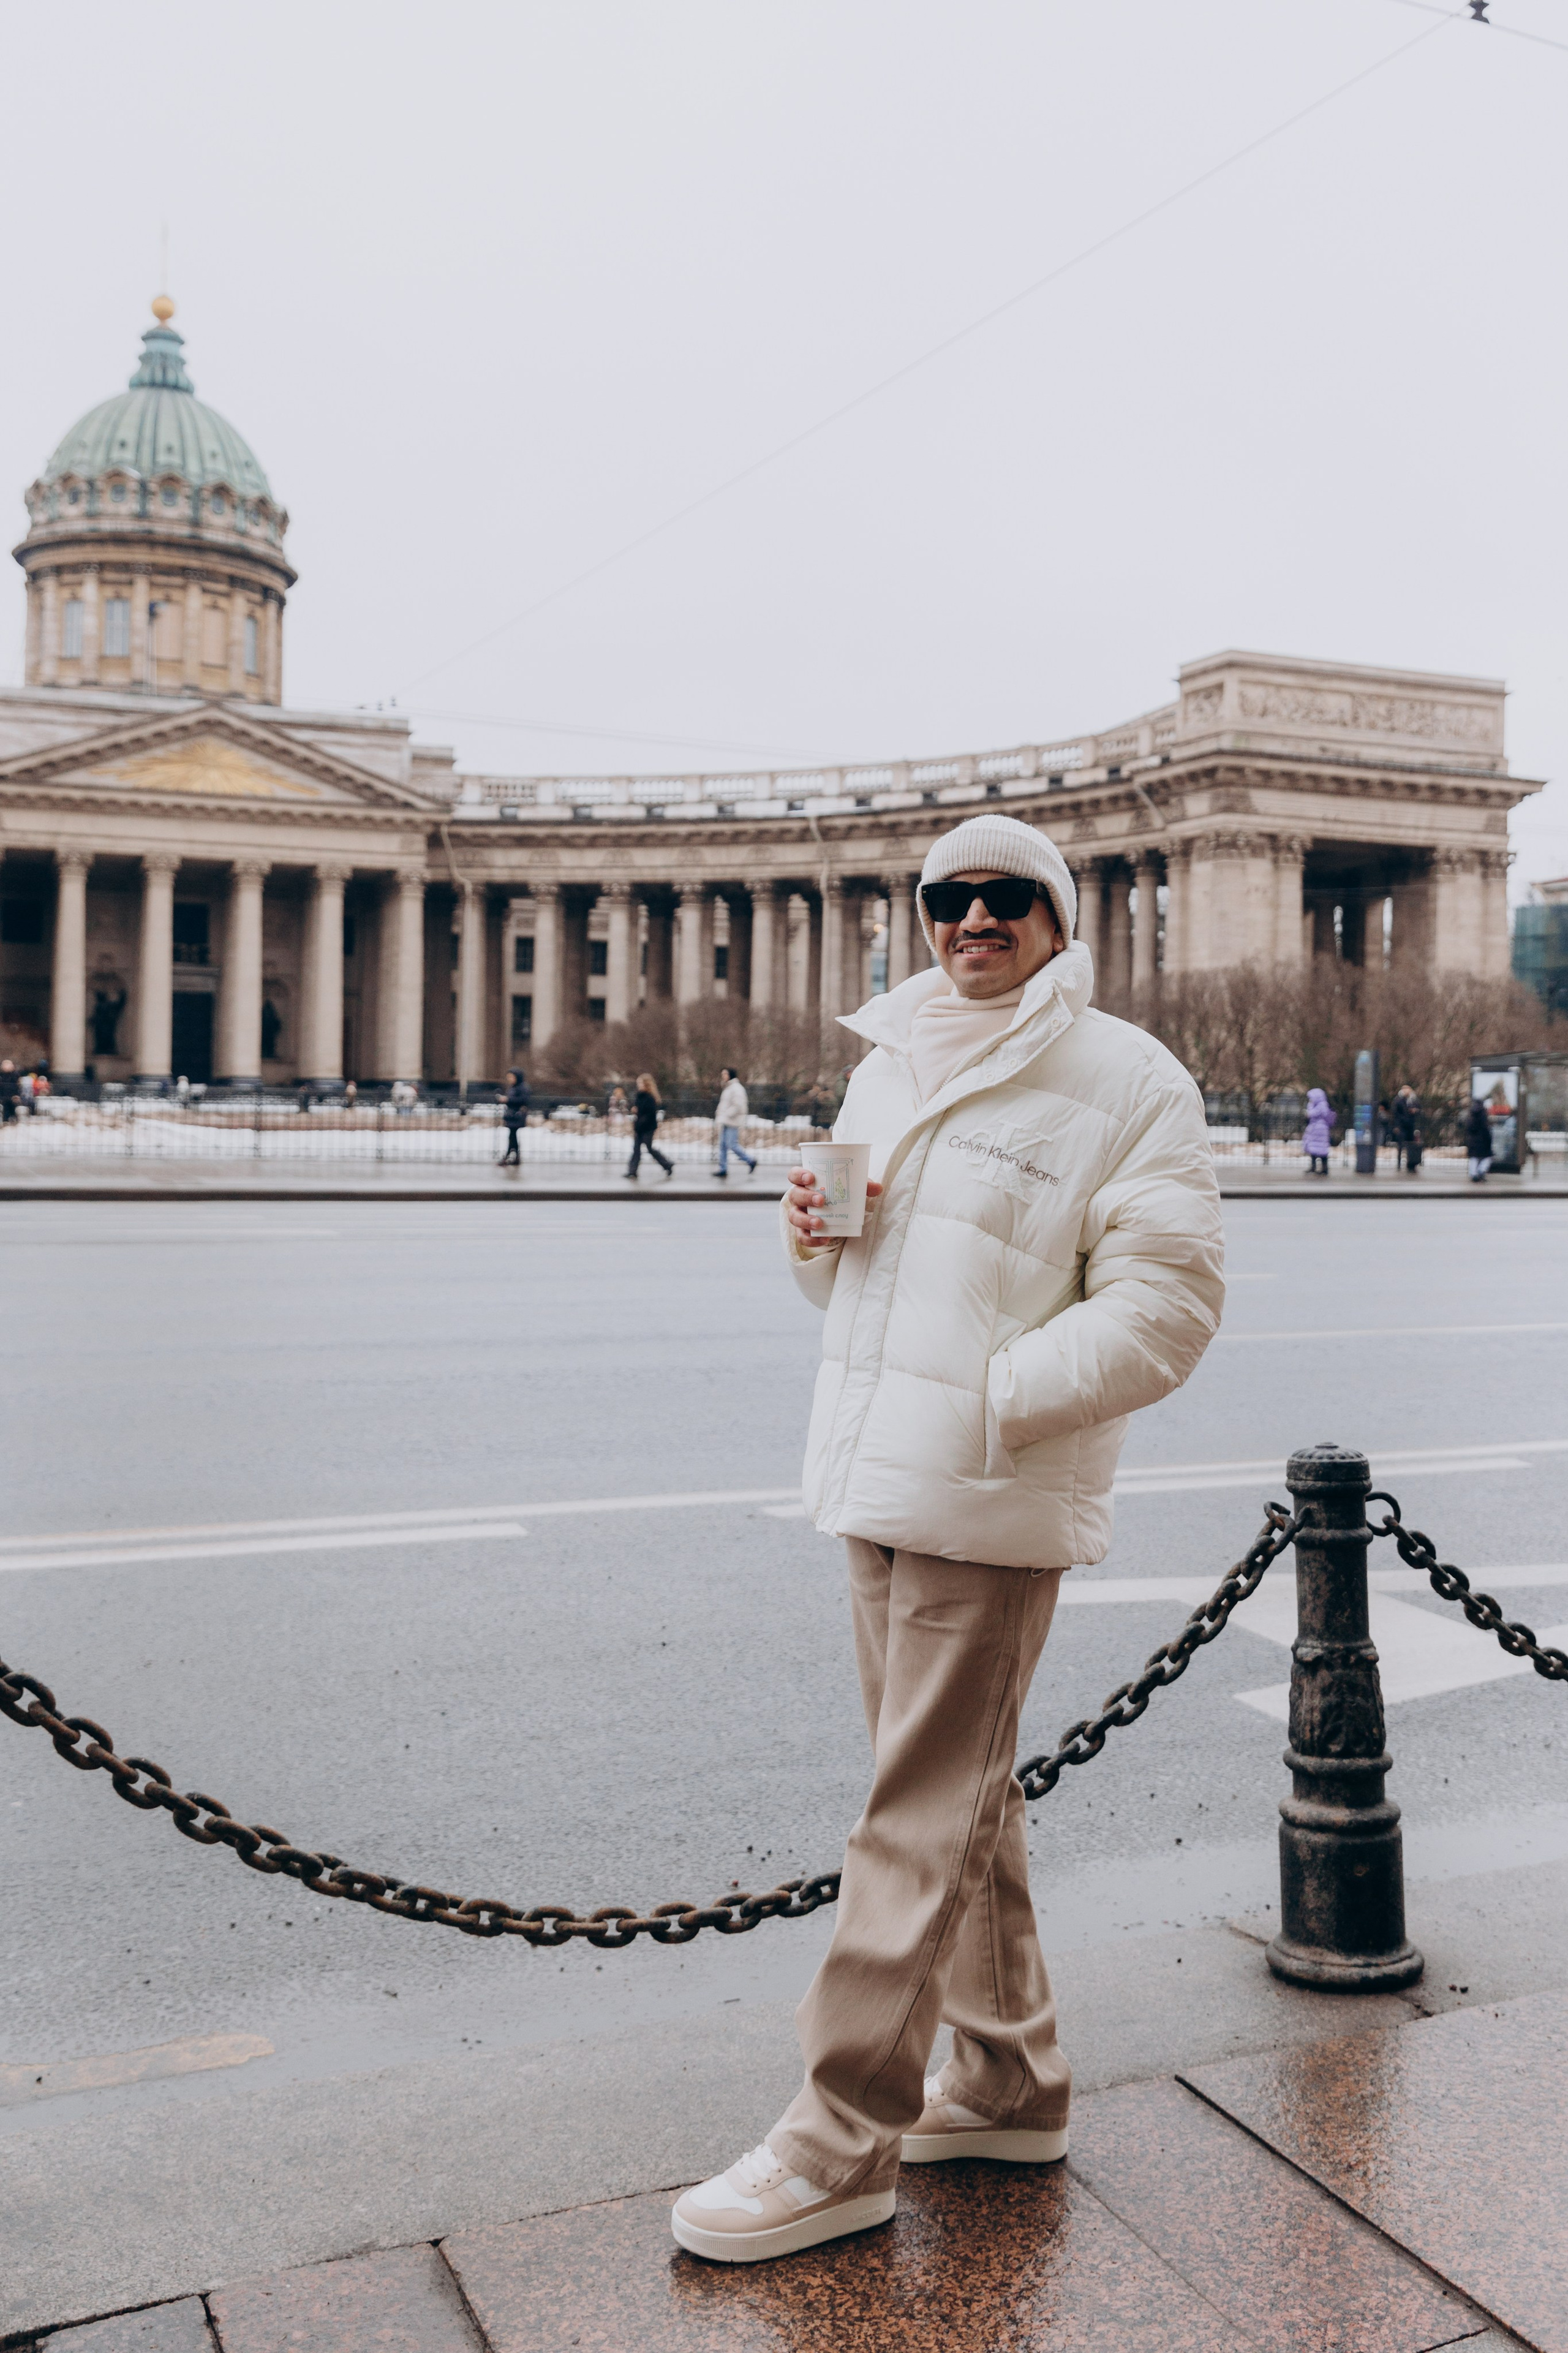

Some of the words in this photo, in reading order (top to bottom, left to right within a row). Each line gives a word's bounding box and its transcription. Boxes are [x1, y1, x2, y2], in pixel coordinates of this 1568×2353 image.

[949, 1136, 987, 1155] Calvin
[988, 1146, 1020, 1166] Klein
[1020, 1161, 1060, 1187] Jeans
